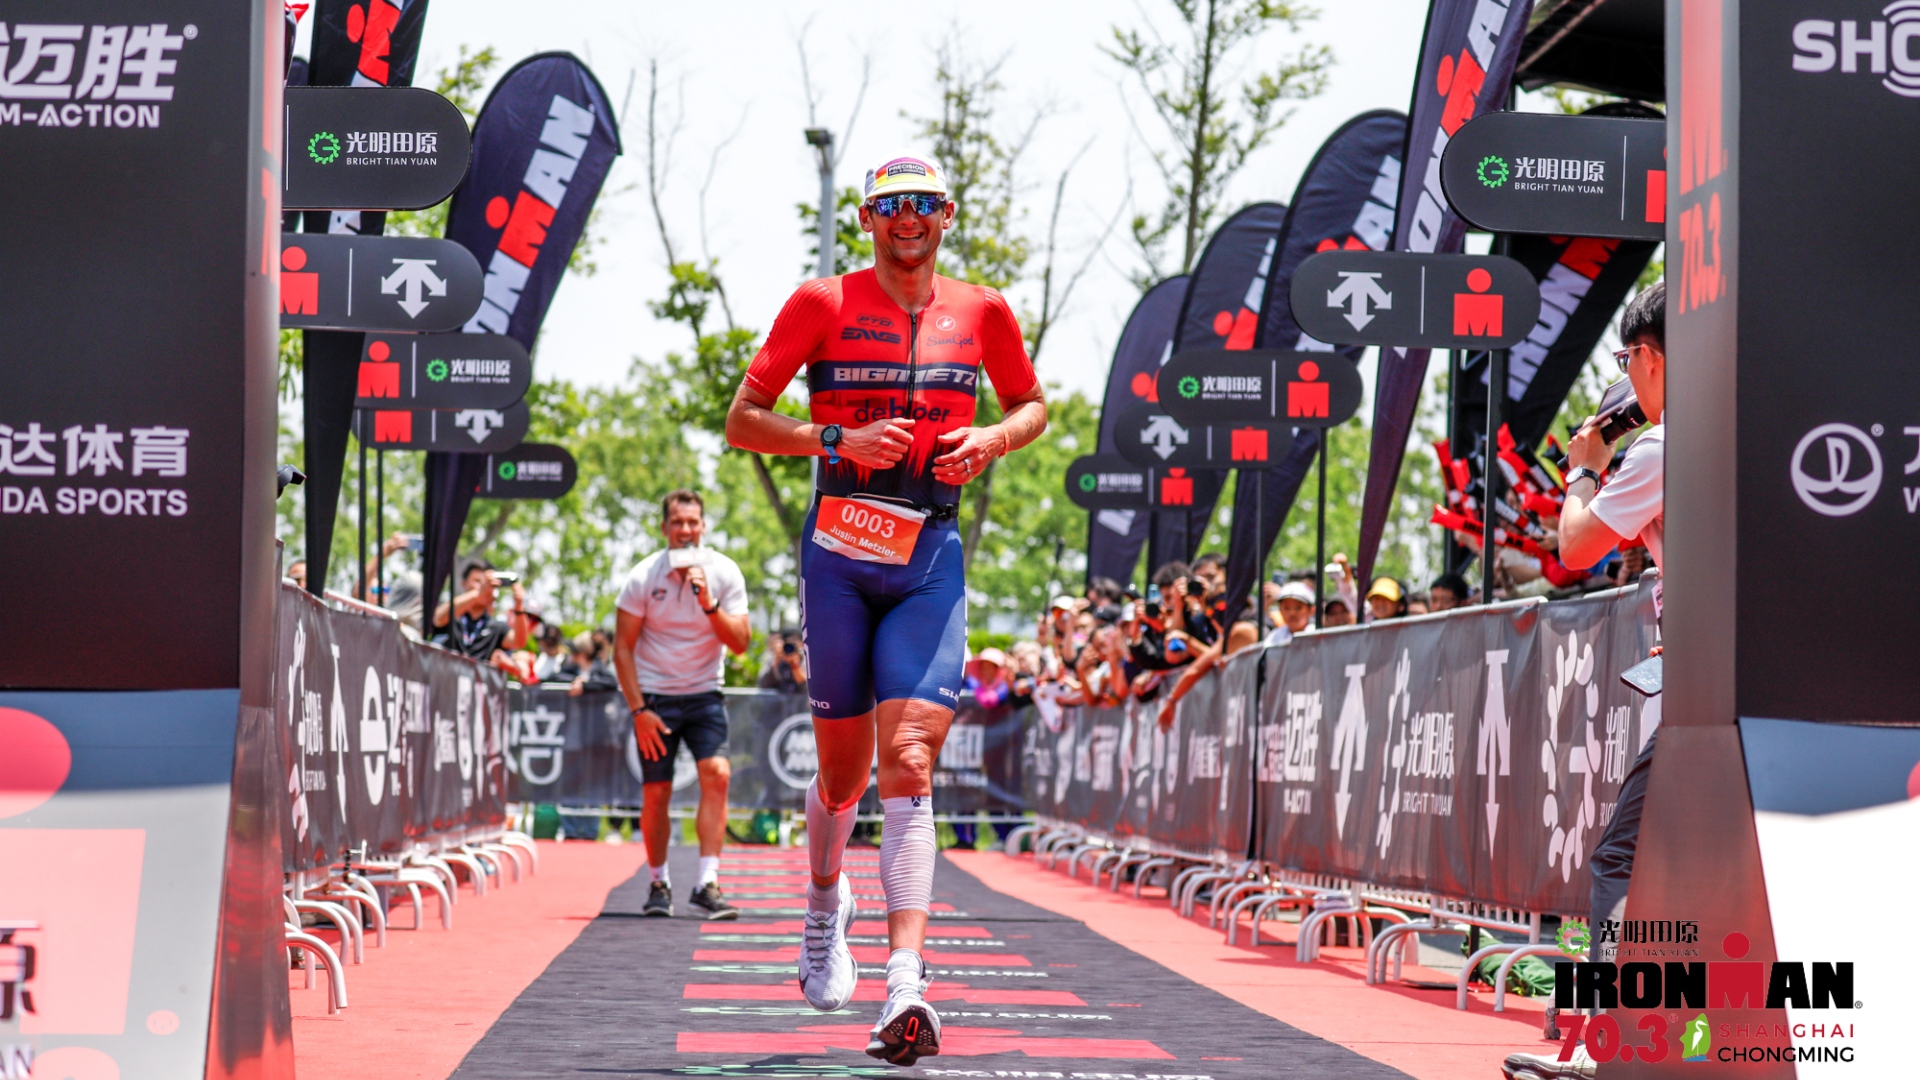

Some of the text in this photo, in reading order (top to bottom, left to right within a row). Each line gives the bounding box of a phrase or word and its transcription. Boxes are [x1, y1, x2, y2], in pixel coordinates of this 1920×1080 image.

[346, 132, 438, 154] 光明田原
[346, 157, 437, 166] BRIGHT TIAN YUAN
[1514, 157, 1605, 182] 光明田原
[1514, 182, 1604, 194] BRIGHT TIAN YUAN
[55, 487, 188, 517] SPORTS
[841, 504, 896, 539] 0003
[830, 525, 896, 557] Justin Metzler
